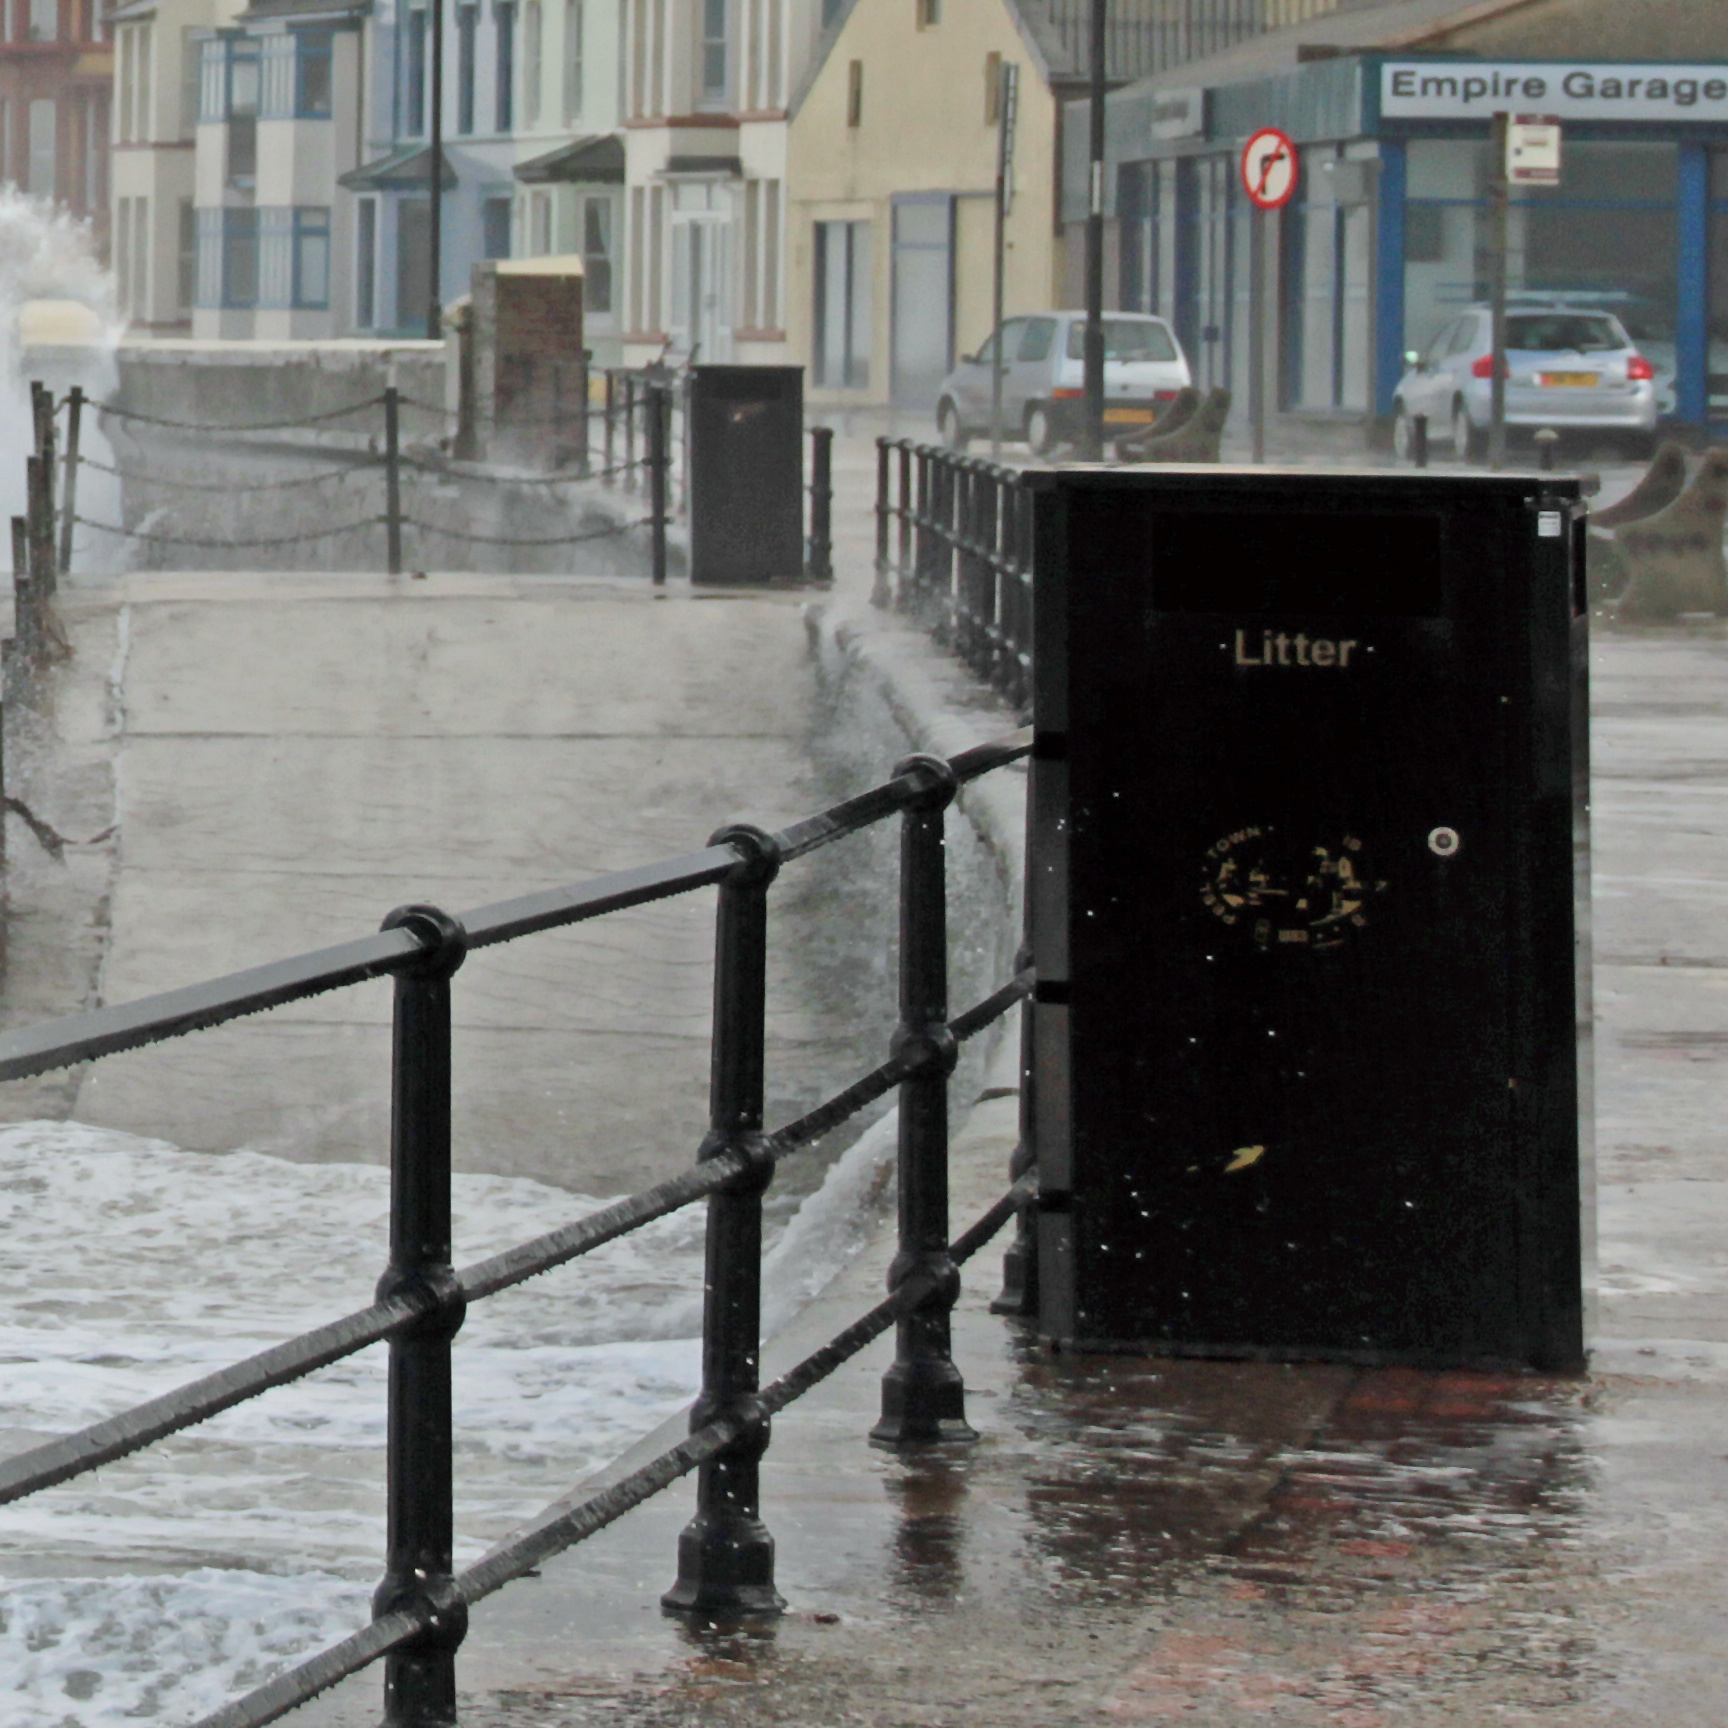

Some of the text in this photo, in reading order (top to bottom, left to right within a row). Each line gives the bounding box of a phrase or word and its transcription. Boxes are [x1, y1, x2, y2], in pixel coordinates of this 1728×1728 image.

[1391, 70, 1727, 106] Empire Garage
[1235, 629, 1357, 667] Litter
